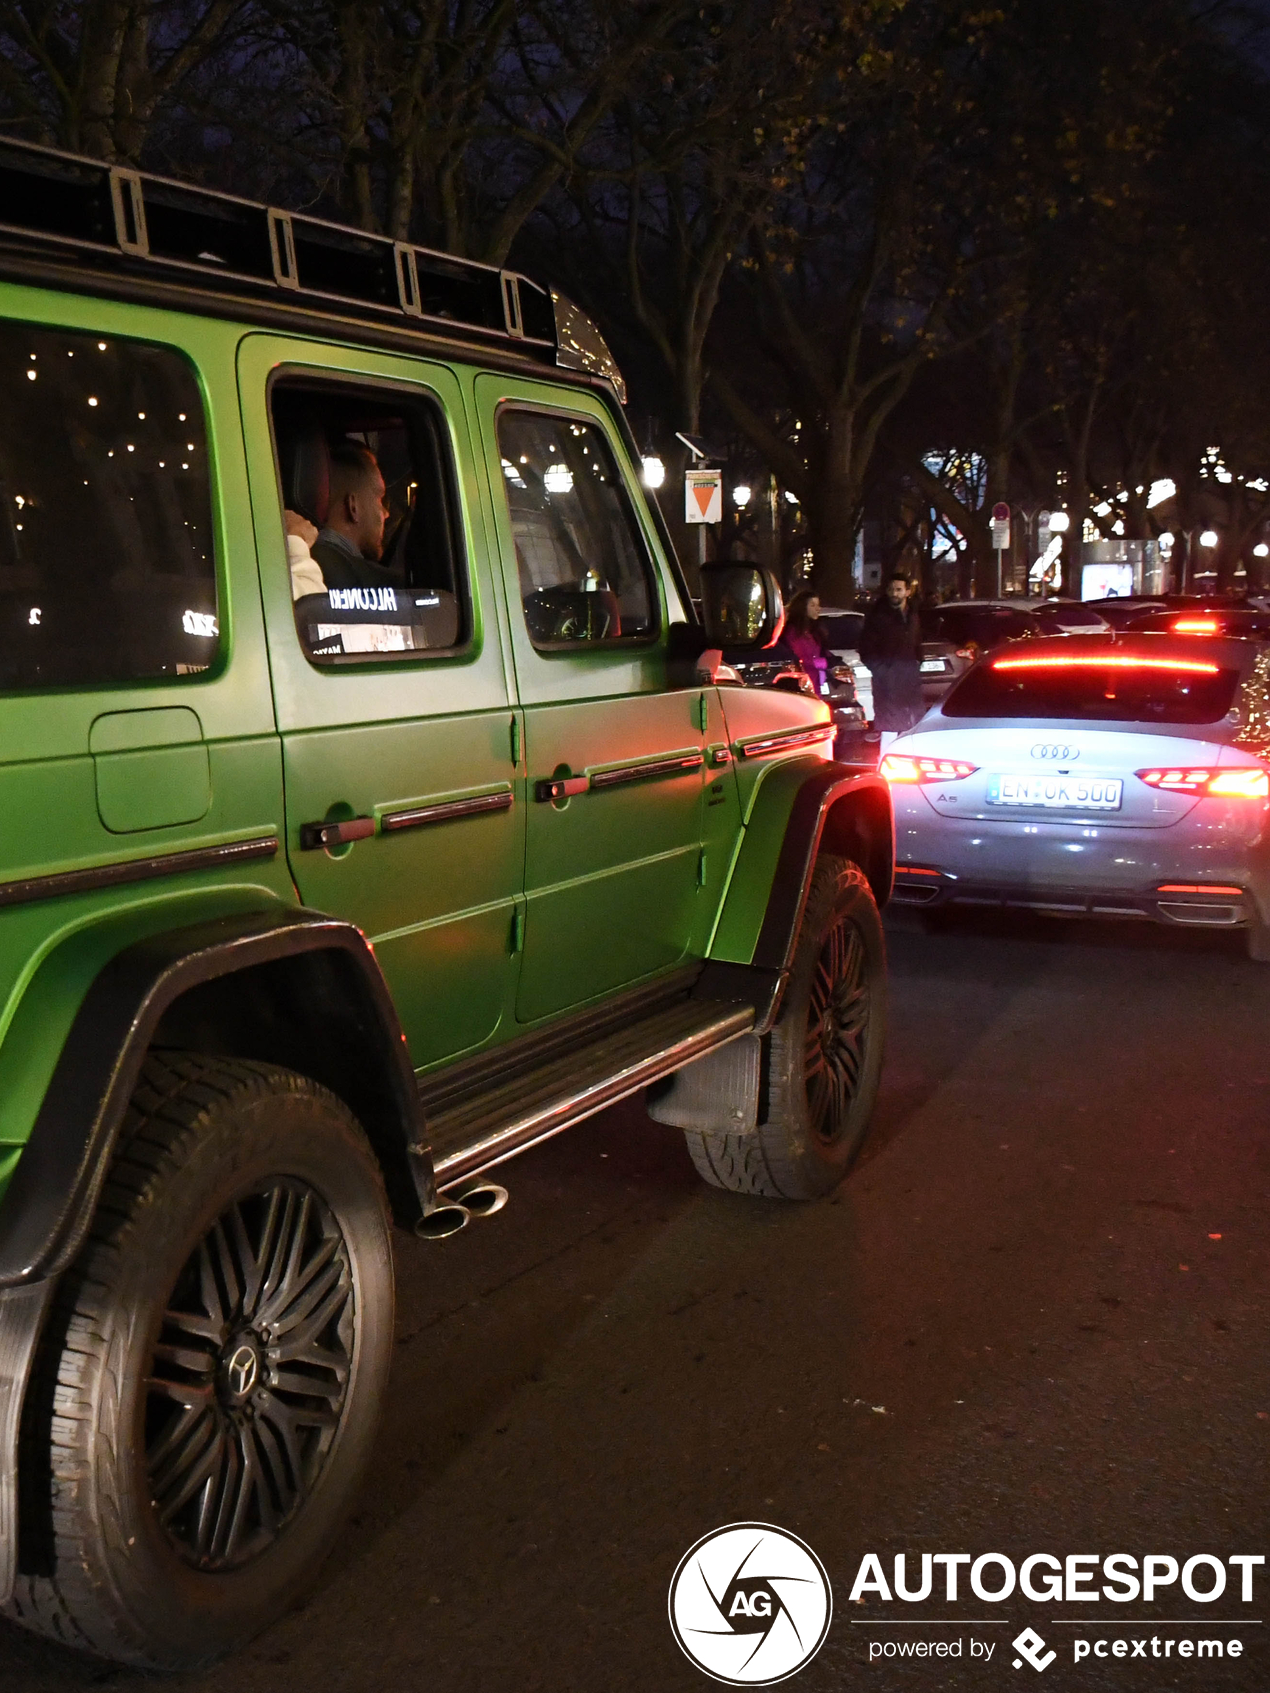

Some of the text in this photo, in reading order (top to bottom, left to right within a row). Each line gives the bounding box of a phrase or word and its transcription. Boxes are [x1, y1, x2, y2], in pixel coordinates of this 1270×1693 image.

[936, 793, 958, 803] A5
[1002, 779, 1116, 803] EN OK 500
